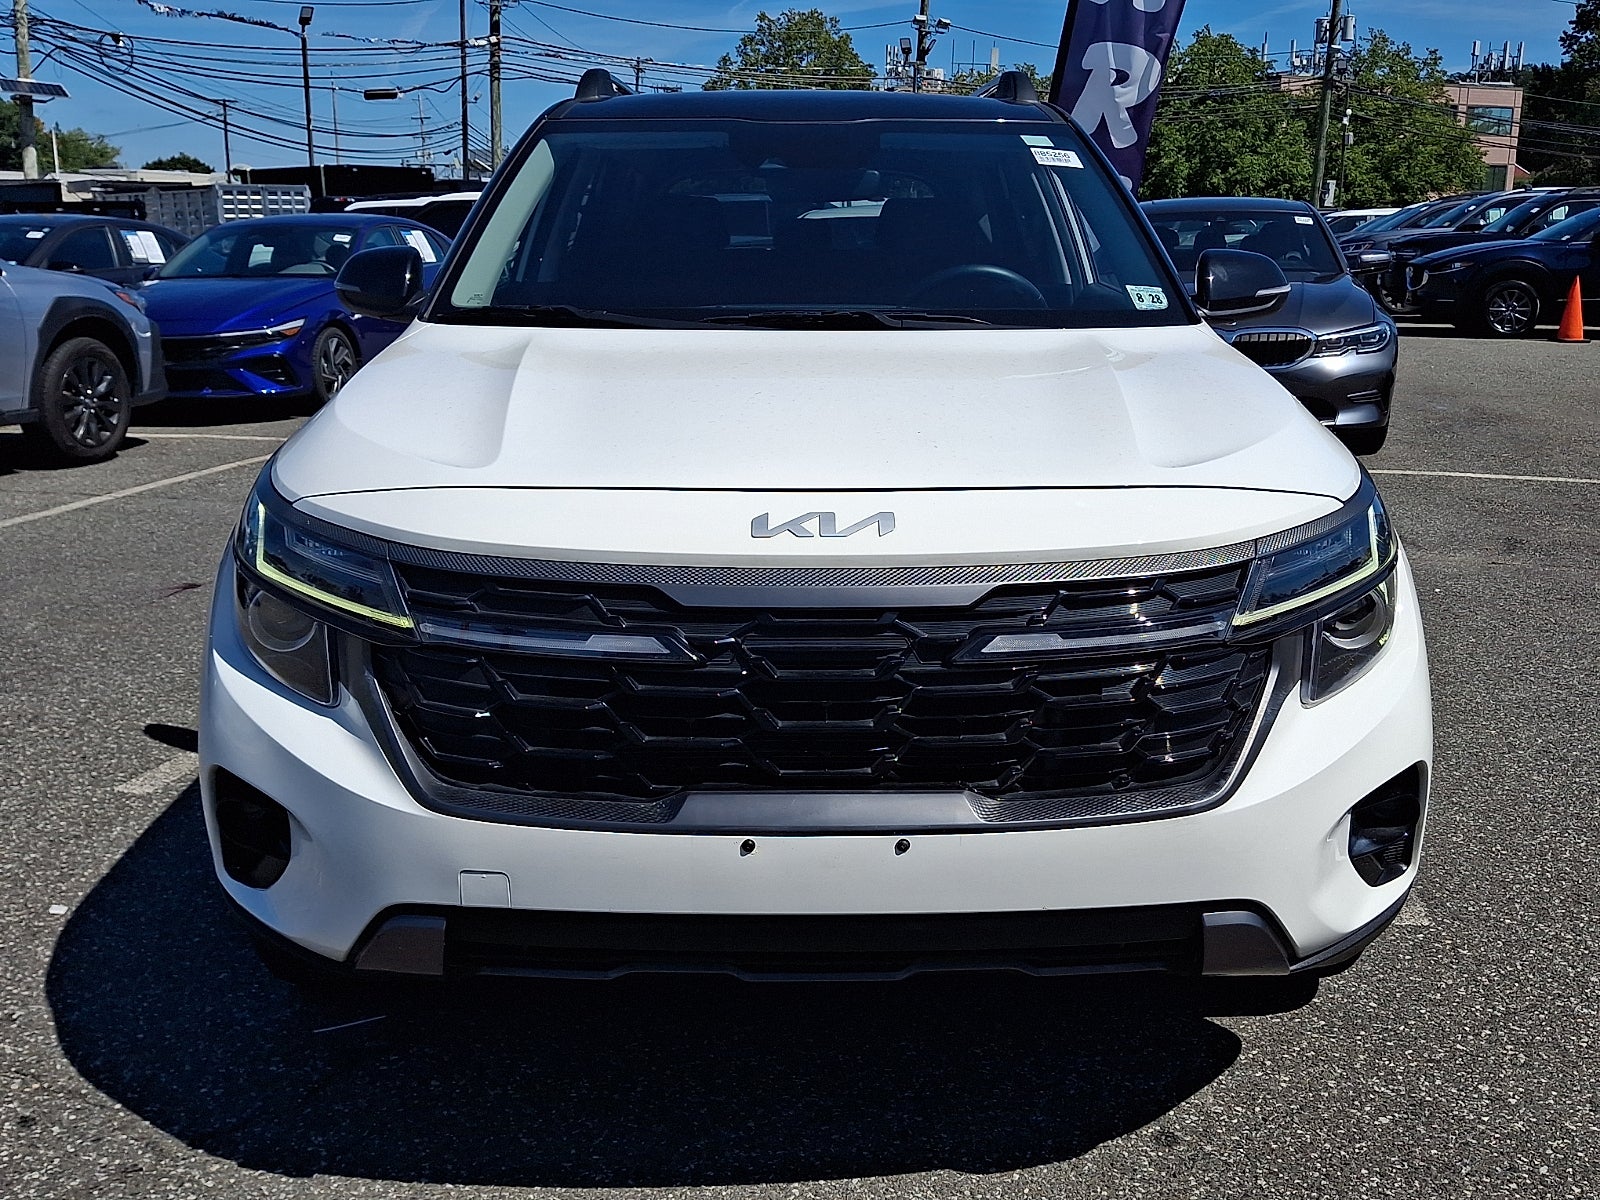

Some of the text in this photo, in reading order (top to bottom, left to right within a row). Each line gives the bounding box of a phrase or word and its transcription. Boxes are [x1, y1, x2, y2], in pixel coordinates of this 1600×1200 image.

[1136, 293, 1163, 304] 8 28
[751, 511, 896, 538] KIA
